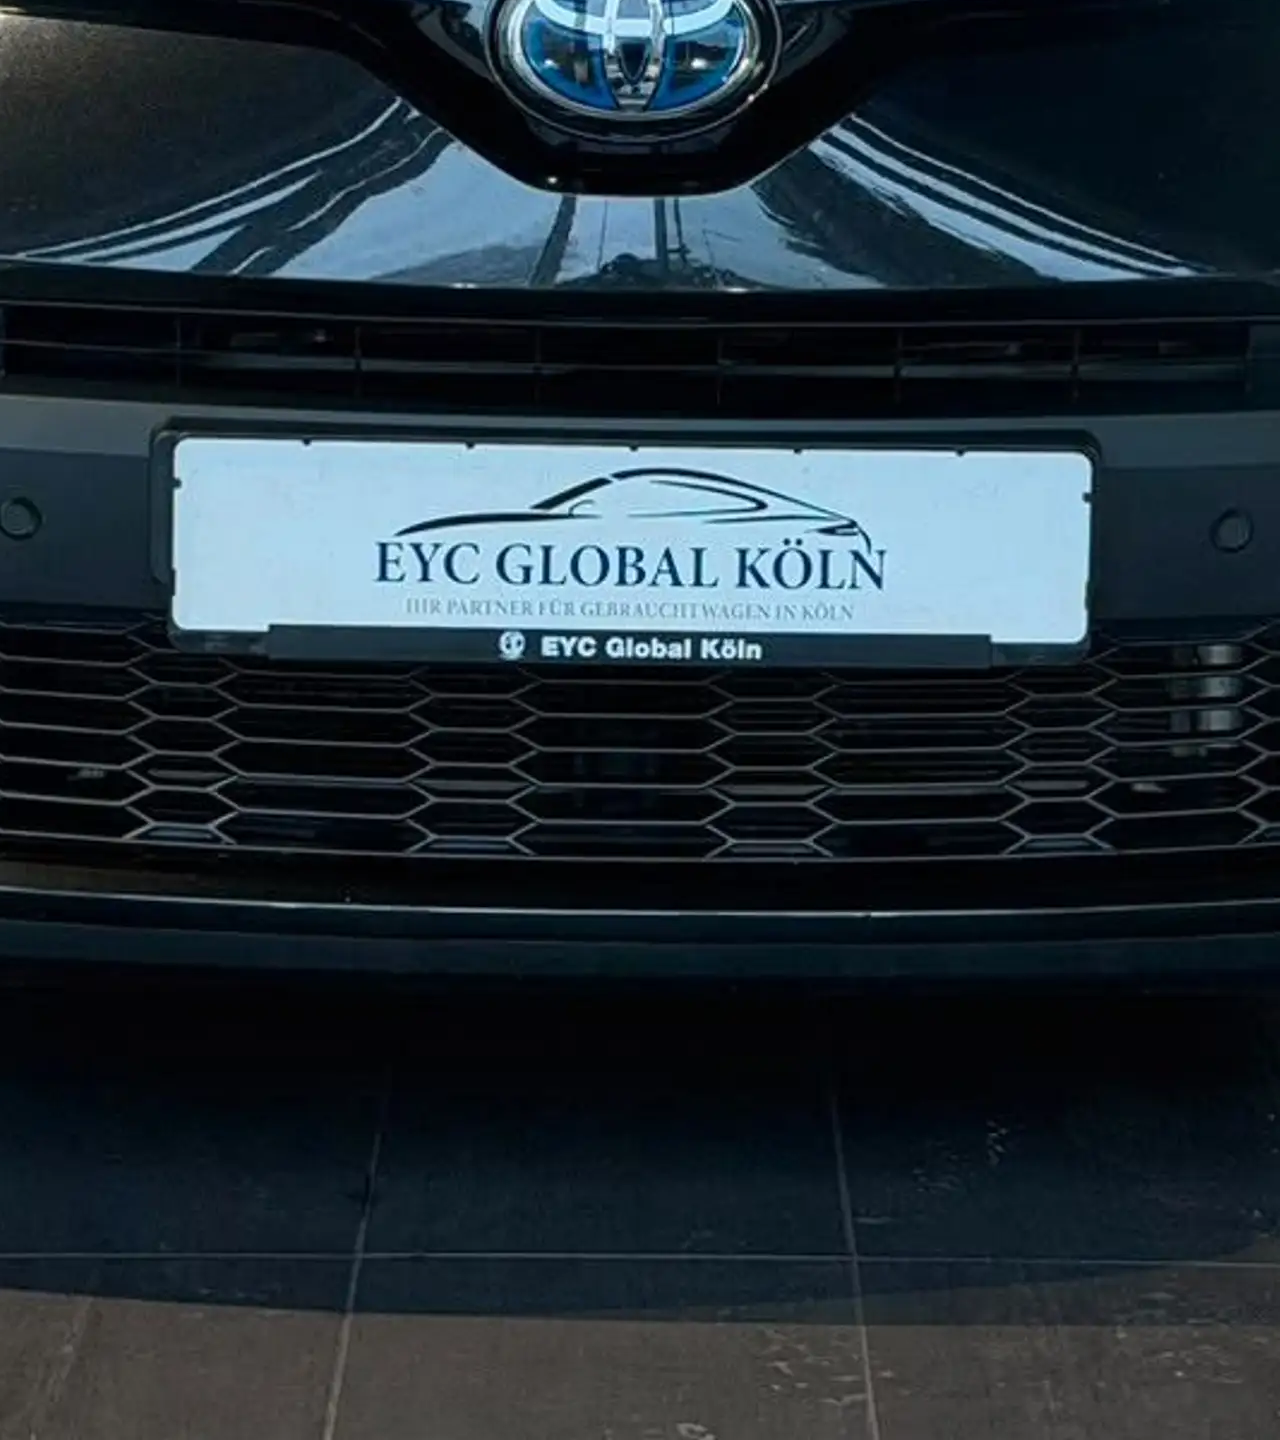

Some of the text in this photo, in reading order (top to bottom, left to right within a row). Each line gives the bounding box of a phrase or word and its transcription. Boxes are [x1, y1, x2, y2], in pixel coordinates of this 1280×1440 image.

[374, 537, 888, 591] EYC GLOBAL KÖLN
[405, 597, 443, 615] IHR
[446, 598, 534, 617] PARTNER
[538, 597, 577, 617] FÜR
[775, 603, 797, 621] IN
[801, 601, 854, 622] KÖLN
[540, 635, 764, 661] EYC Global Köln
